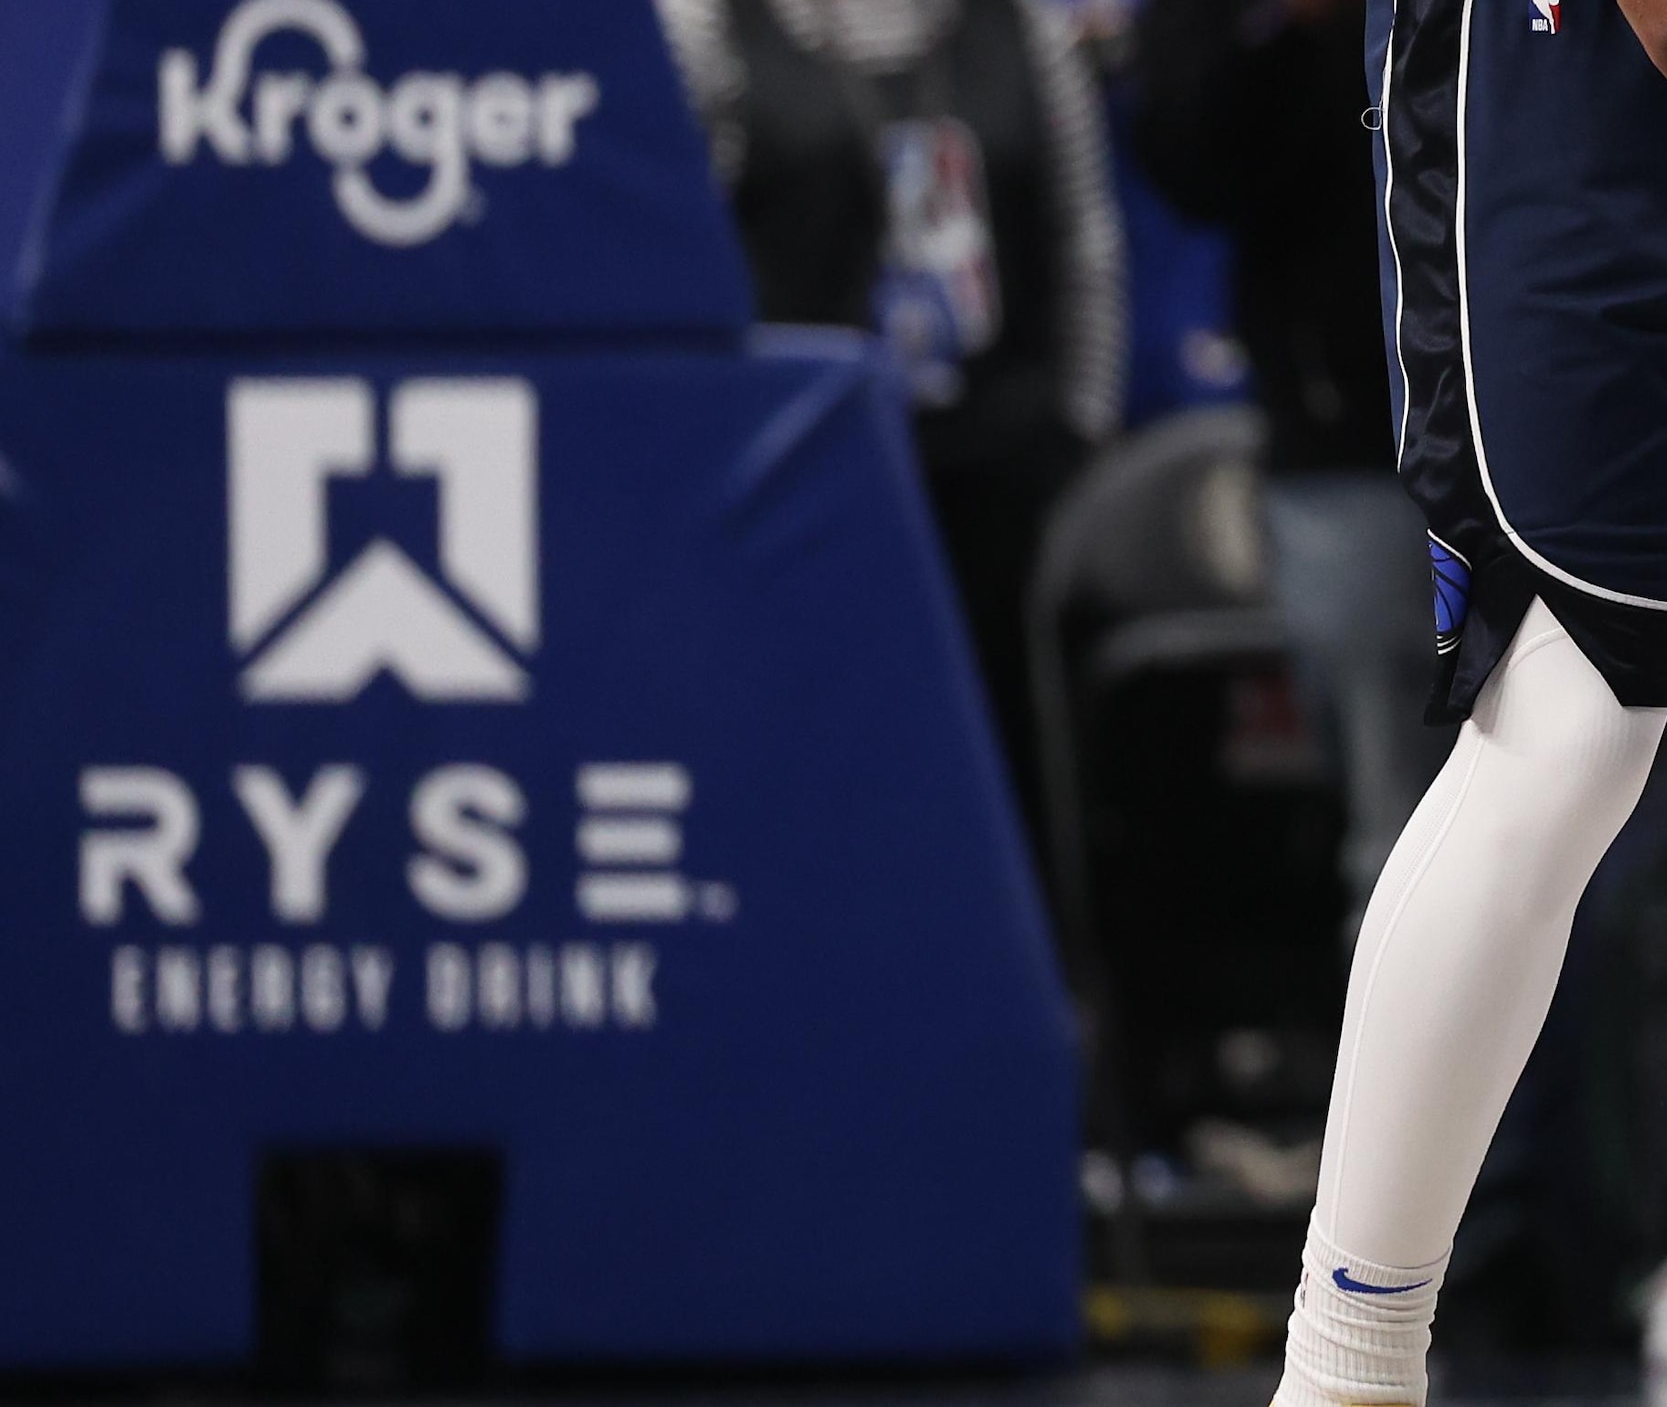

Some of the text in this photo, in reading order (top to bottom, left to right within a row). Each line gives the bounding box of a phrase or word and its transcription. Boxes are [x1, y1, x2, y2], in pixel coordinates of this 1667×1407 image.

[1532, 18, 1549, 32] NBA
[78, 764, 692, 924] RYSE
[111, 941, 658, 1032] ENERGY DRINK
